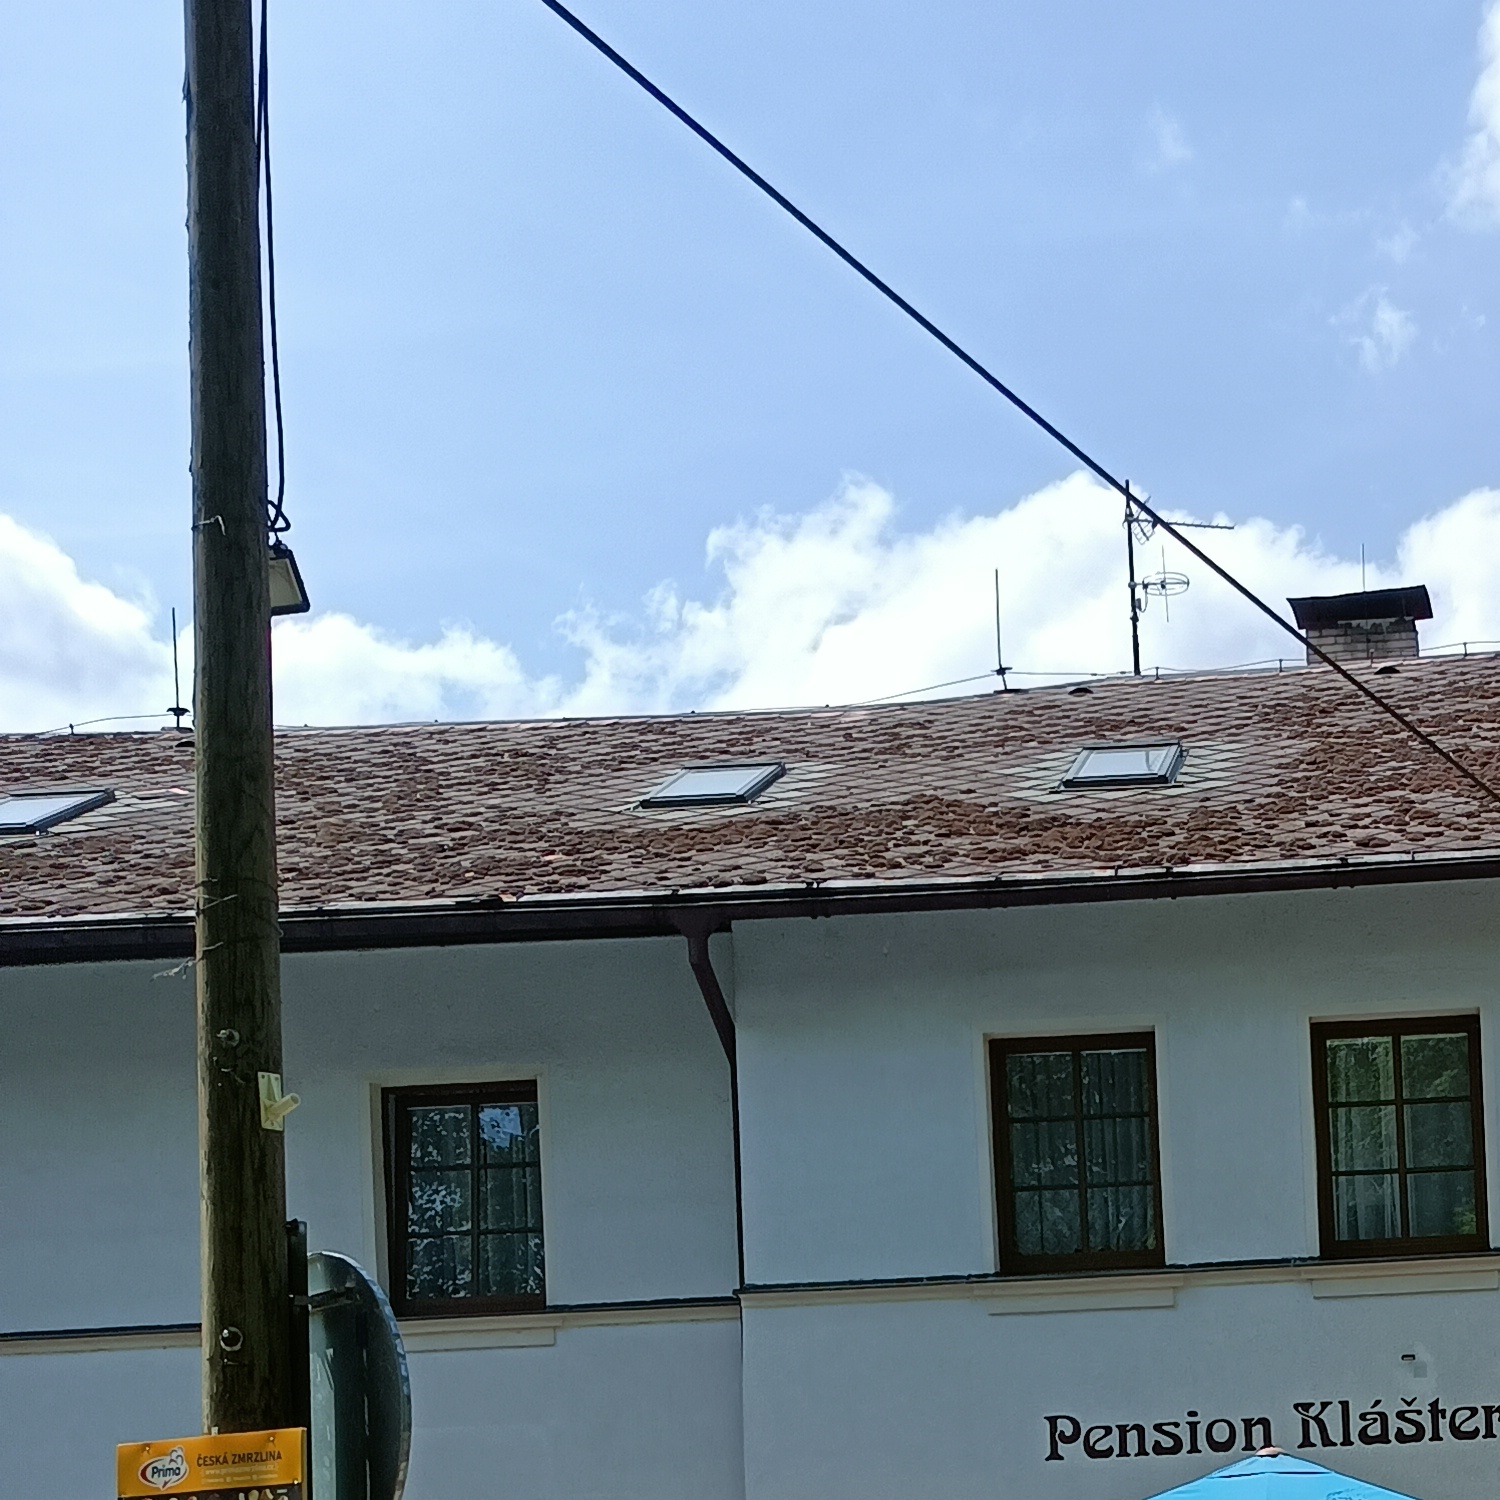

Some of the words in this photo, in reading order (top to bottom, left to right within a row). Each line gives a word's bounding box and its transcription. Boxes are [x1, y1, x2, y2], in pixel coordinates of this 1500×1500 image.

[1043, 1410, 1277, 1462] Pension
[196, 1452, 229, 1468] ČESKÁ
[231, 1450, 283, 1465] ZMRZLINA
[151, 1465, 181, 1479] Prima
